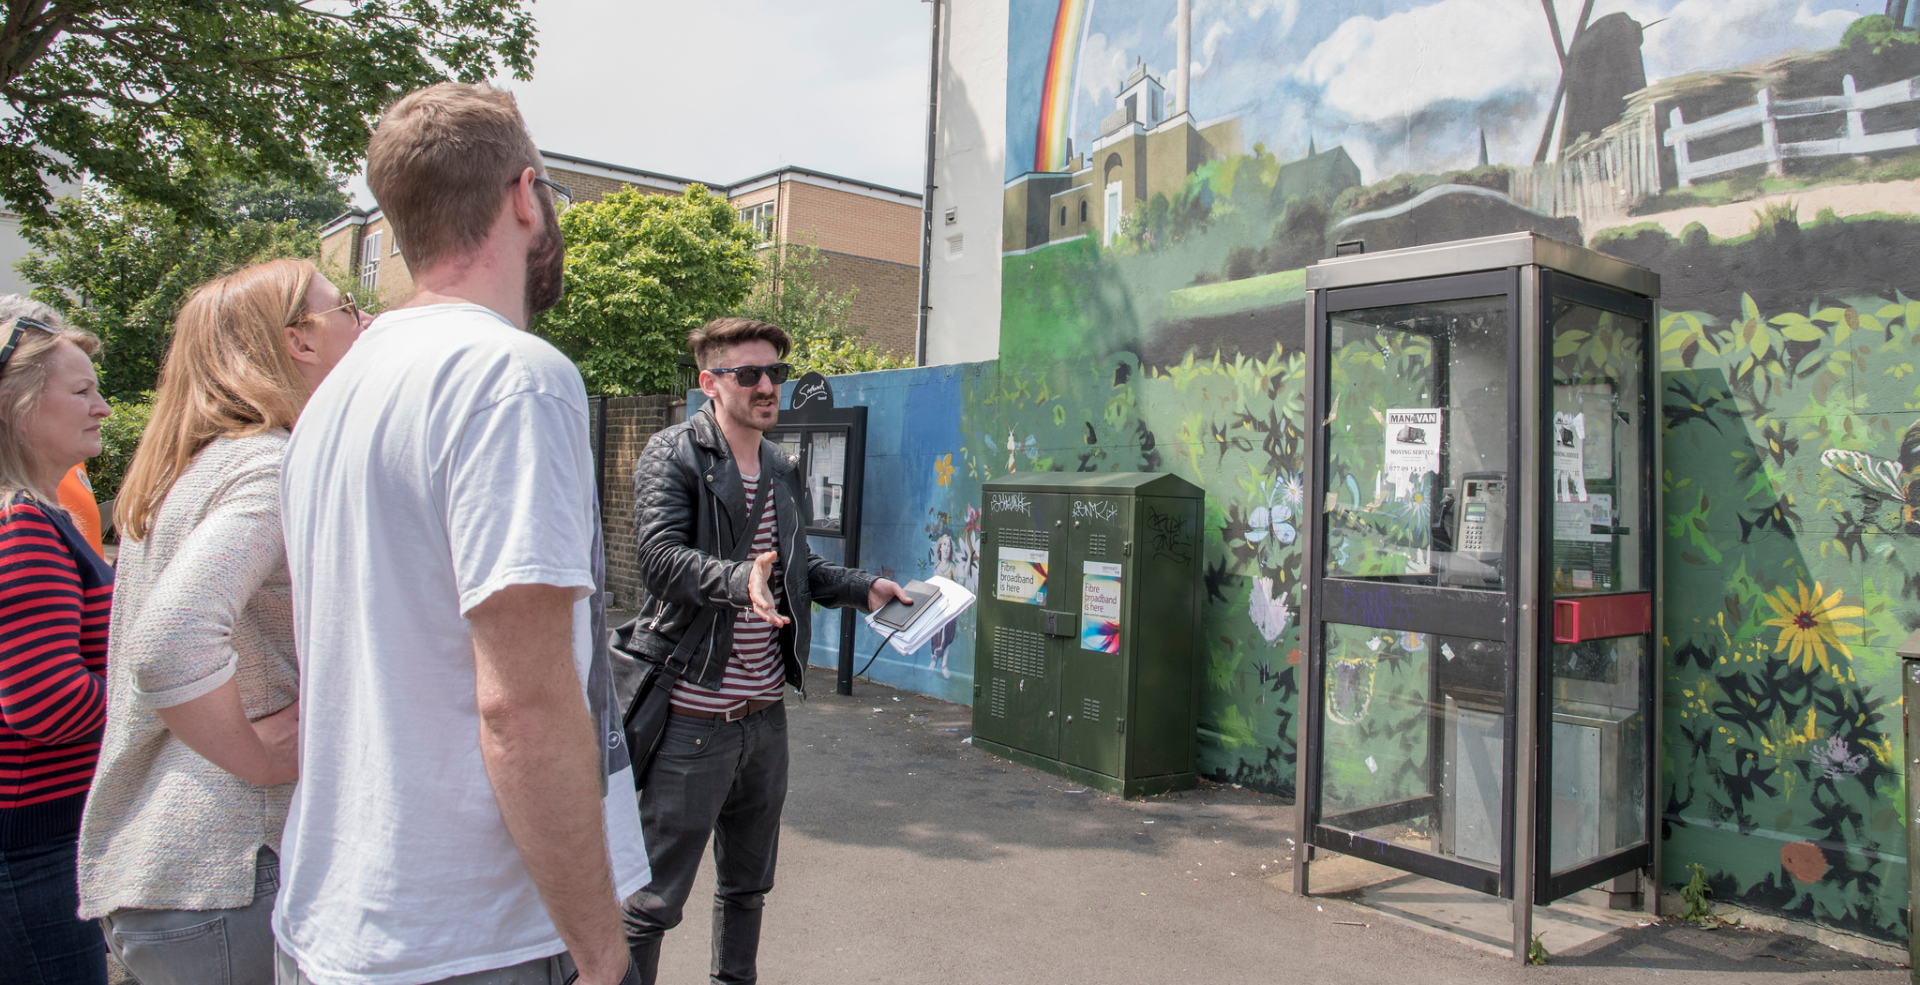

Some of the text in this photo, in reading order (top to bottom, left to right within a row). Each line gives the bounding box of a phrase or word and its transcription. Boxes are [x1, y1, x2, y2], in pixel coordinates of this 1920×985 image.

[1390, 414, 1411, 423] MAN
[1416, 414, 1436, 423] VAN
[1000, 561, 1016, 573] Fibre
[1000, 572, 1034, 585] broadband
[999, 581, 1020, 593] is here
[1084, 582, 1100, 594] Fibre
[1084, 592, 1117, 605] broadband
[1084, 601, 1104, 613] is here
